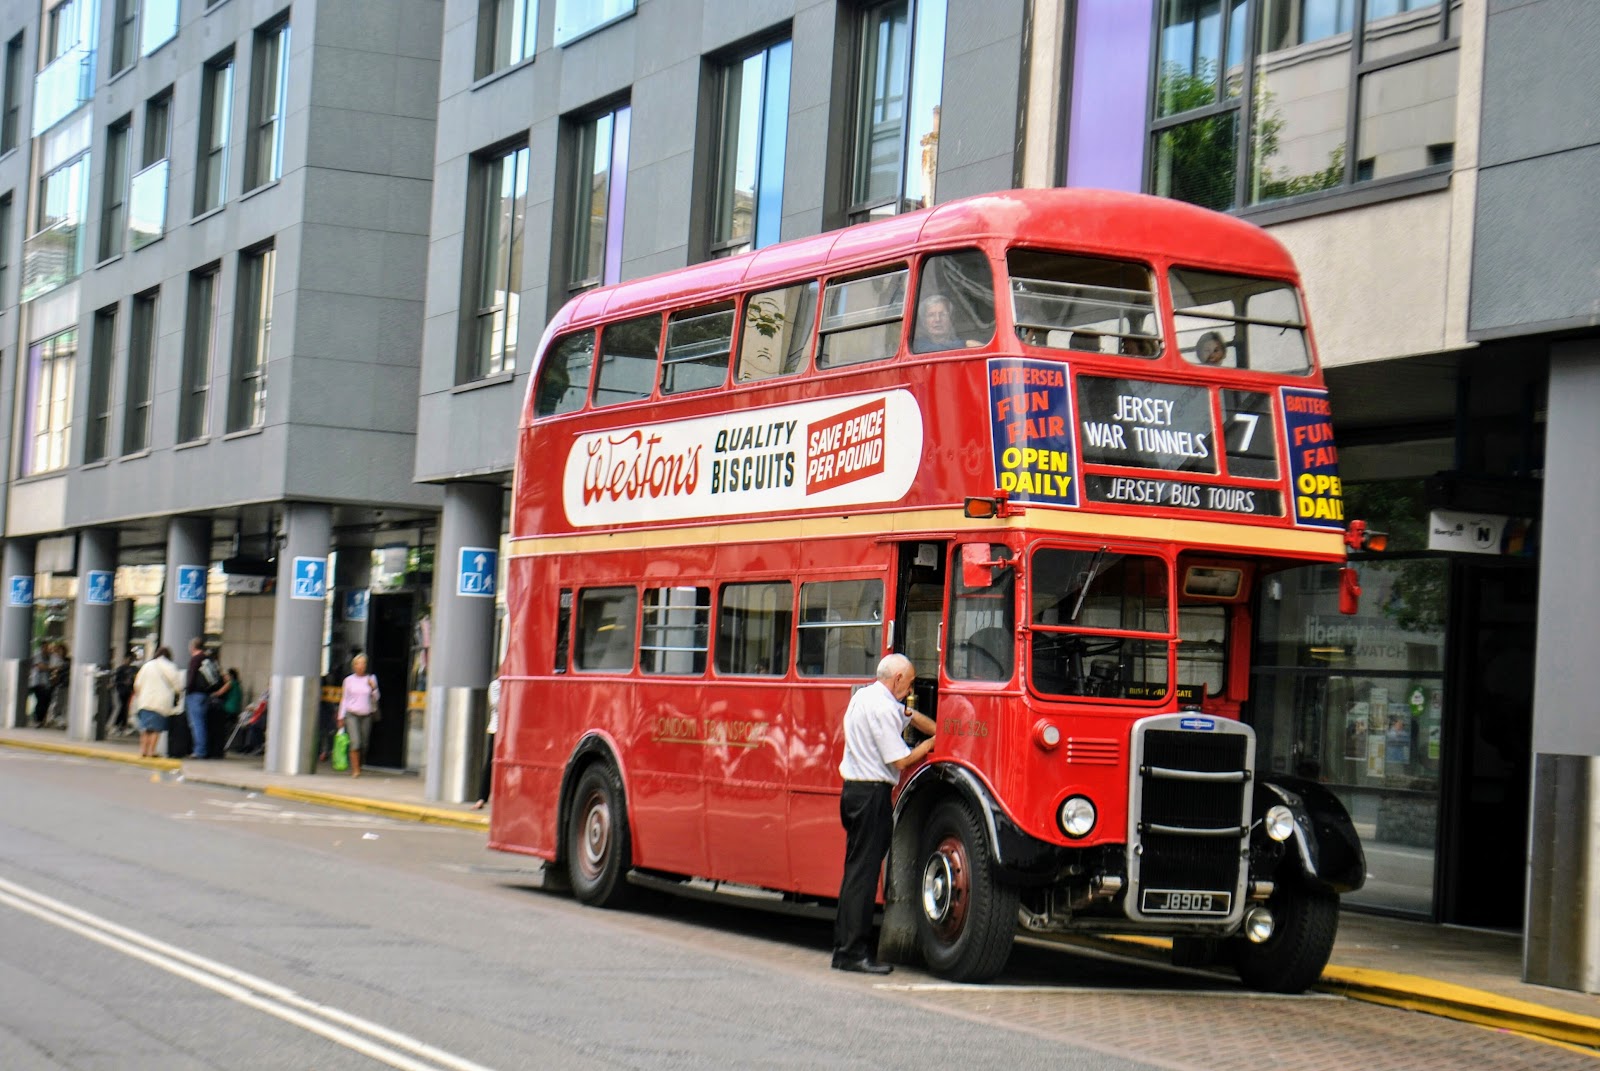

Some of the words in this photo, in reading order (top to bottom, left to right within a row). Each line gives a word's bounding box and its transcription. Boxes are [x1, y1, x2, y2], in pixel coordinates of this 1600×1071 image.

[991, 367, 1064, 388] BATTERSEA
[996, 390, 1050, 421] FUN
[1113, 394, 1175, 426] JERSEY
[715, 420, 798, 454] QUALITY
[807, 422, 843, 458] SAVE
[843, 408, 884, 450] PENCE
[1006, 415, 1066, 444] FAIR
[1083, 421, 1127, 450] WAR
[1132, 426, 1209, 459] TUNNELS
[1234, 413, 1259, 451] 7
[583, 430, 703, 507] Weston's
[711, 451, 796, 494] BISCUITS
[807, 453, 835, 485] PER
[835, 438, 883, 476] POUND
[1002, 447, 1068, 473] OPEN
[1000, 472, 1072, 498] DAILY
[1106, 477, 1165, 503] JERSEY
[1171, 483, 1201, 508] BUS
[1207, 487, 1255, 513] TOURS
[1160, 892, 1213, 911] J8903
